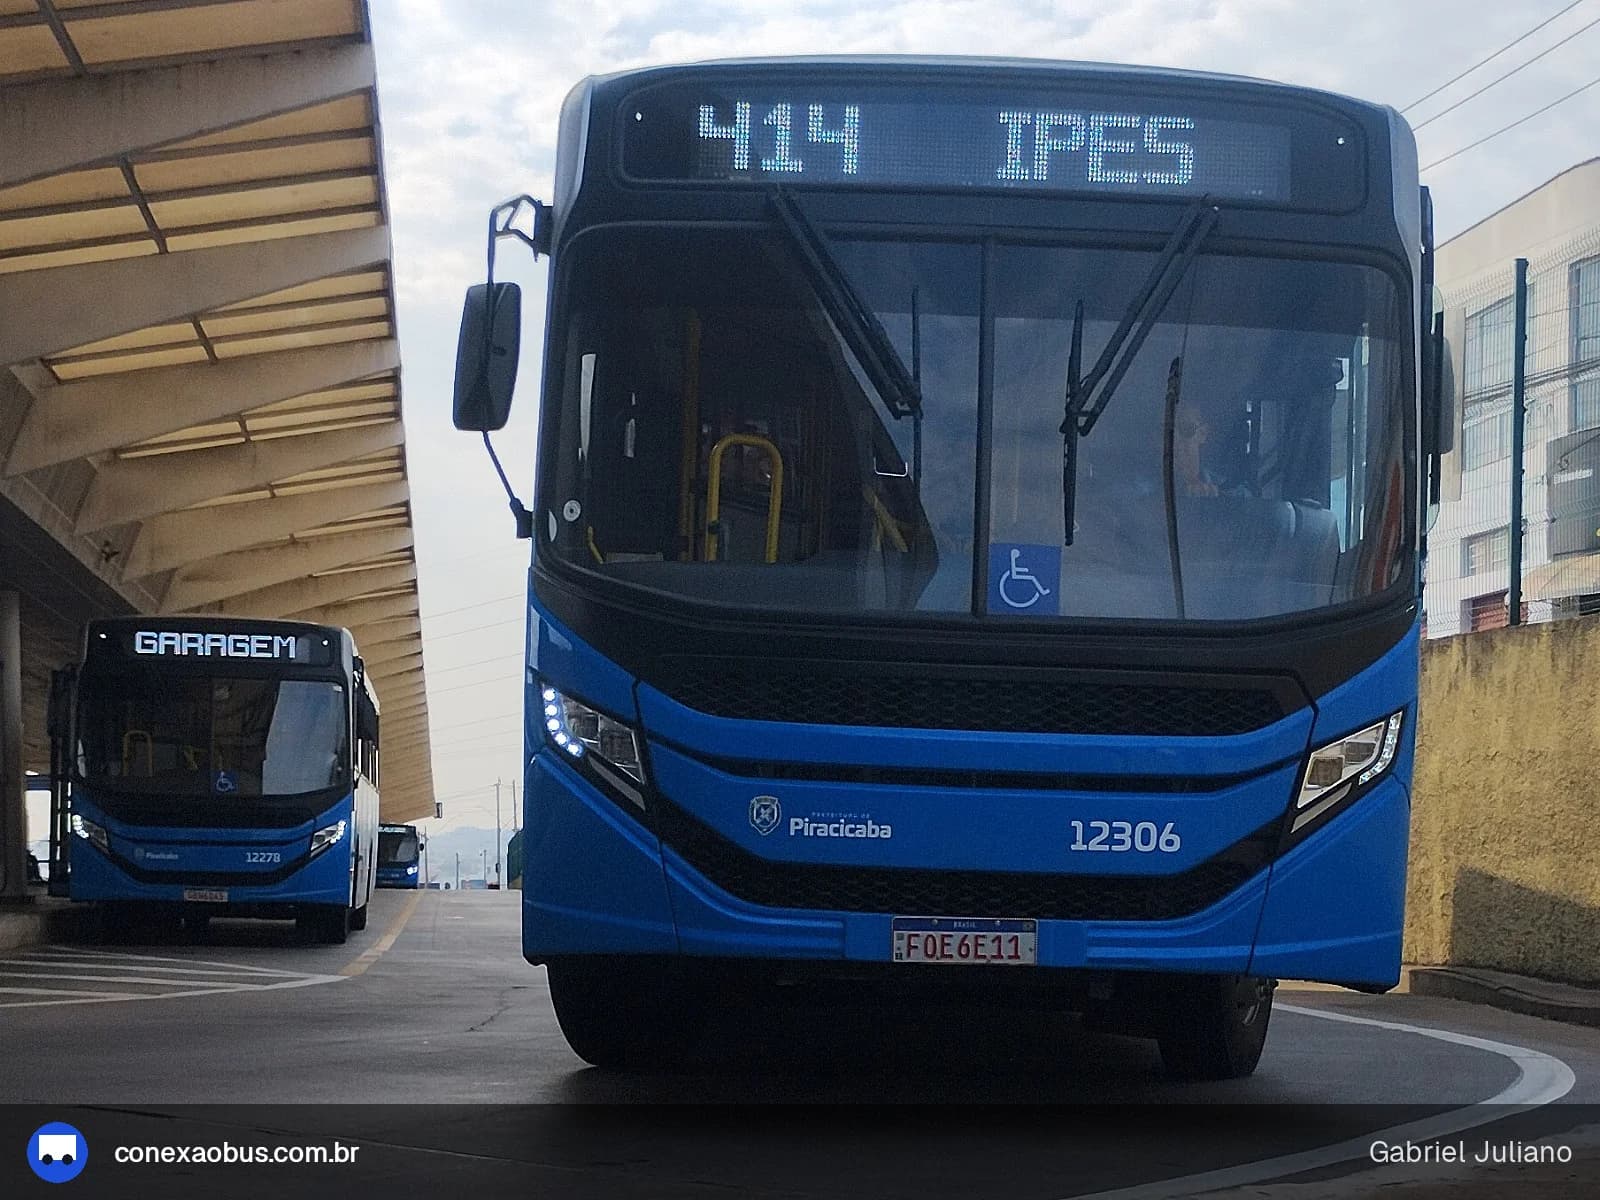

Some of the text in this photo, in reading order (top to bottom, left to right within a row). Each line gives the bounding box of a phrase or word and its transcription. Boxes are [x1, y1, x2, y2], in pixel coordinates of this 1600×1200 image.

[699, 101, 1196, 185] 414 IPES
[134, 631, 296, 658] GARAGEM
[789, 817, 893, 839] Piracicaba
[1070, 820, 1182, 854] 12306
[245, 851, 281, 864] 12278
